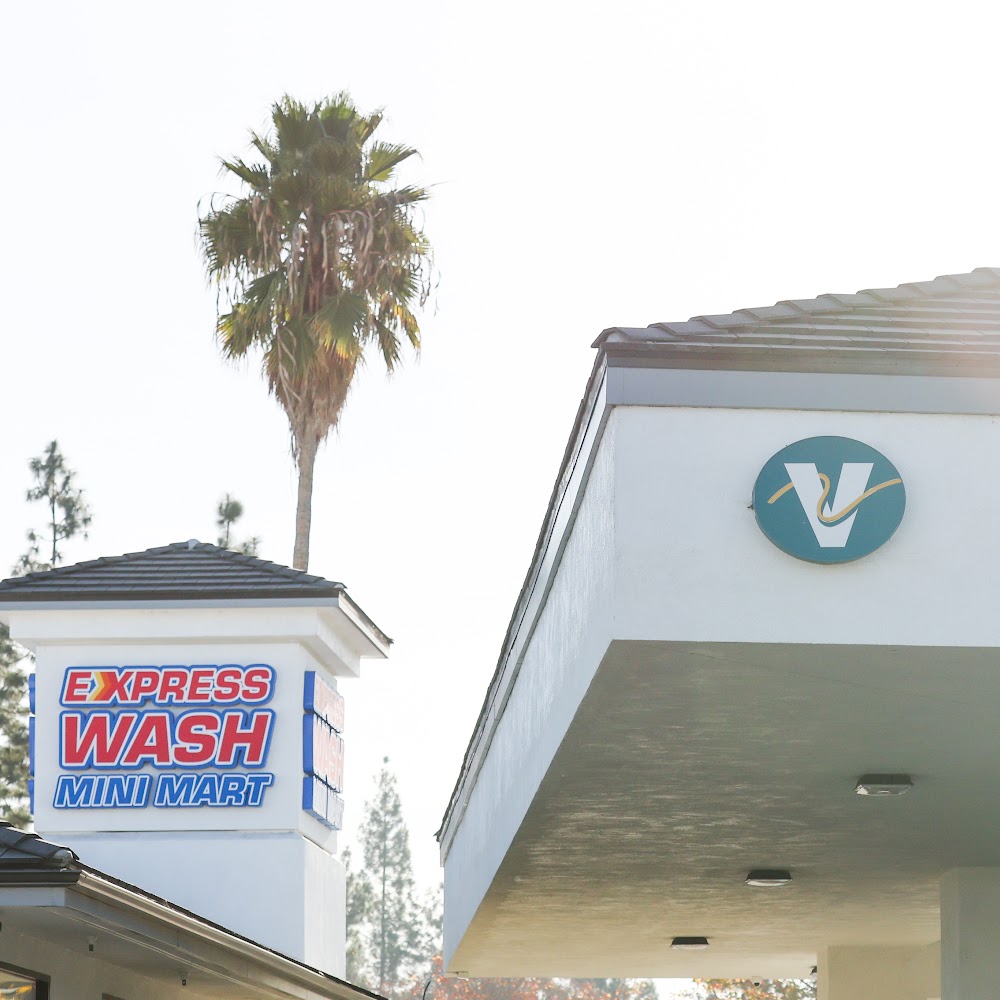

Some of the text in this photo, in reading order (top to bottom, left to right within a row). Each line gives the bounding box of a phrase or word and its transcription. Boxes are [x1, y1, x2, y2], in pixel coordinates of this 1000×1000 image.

[62, 666, 273, 705] EXPRESS
[61, 711, 273, 767] WASH
[55, 774, 273, 807] MINI MART
